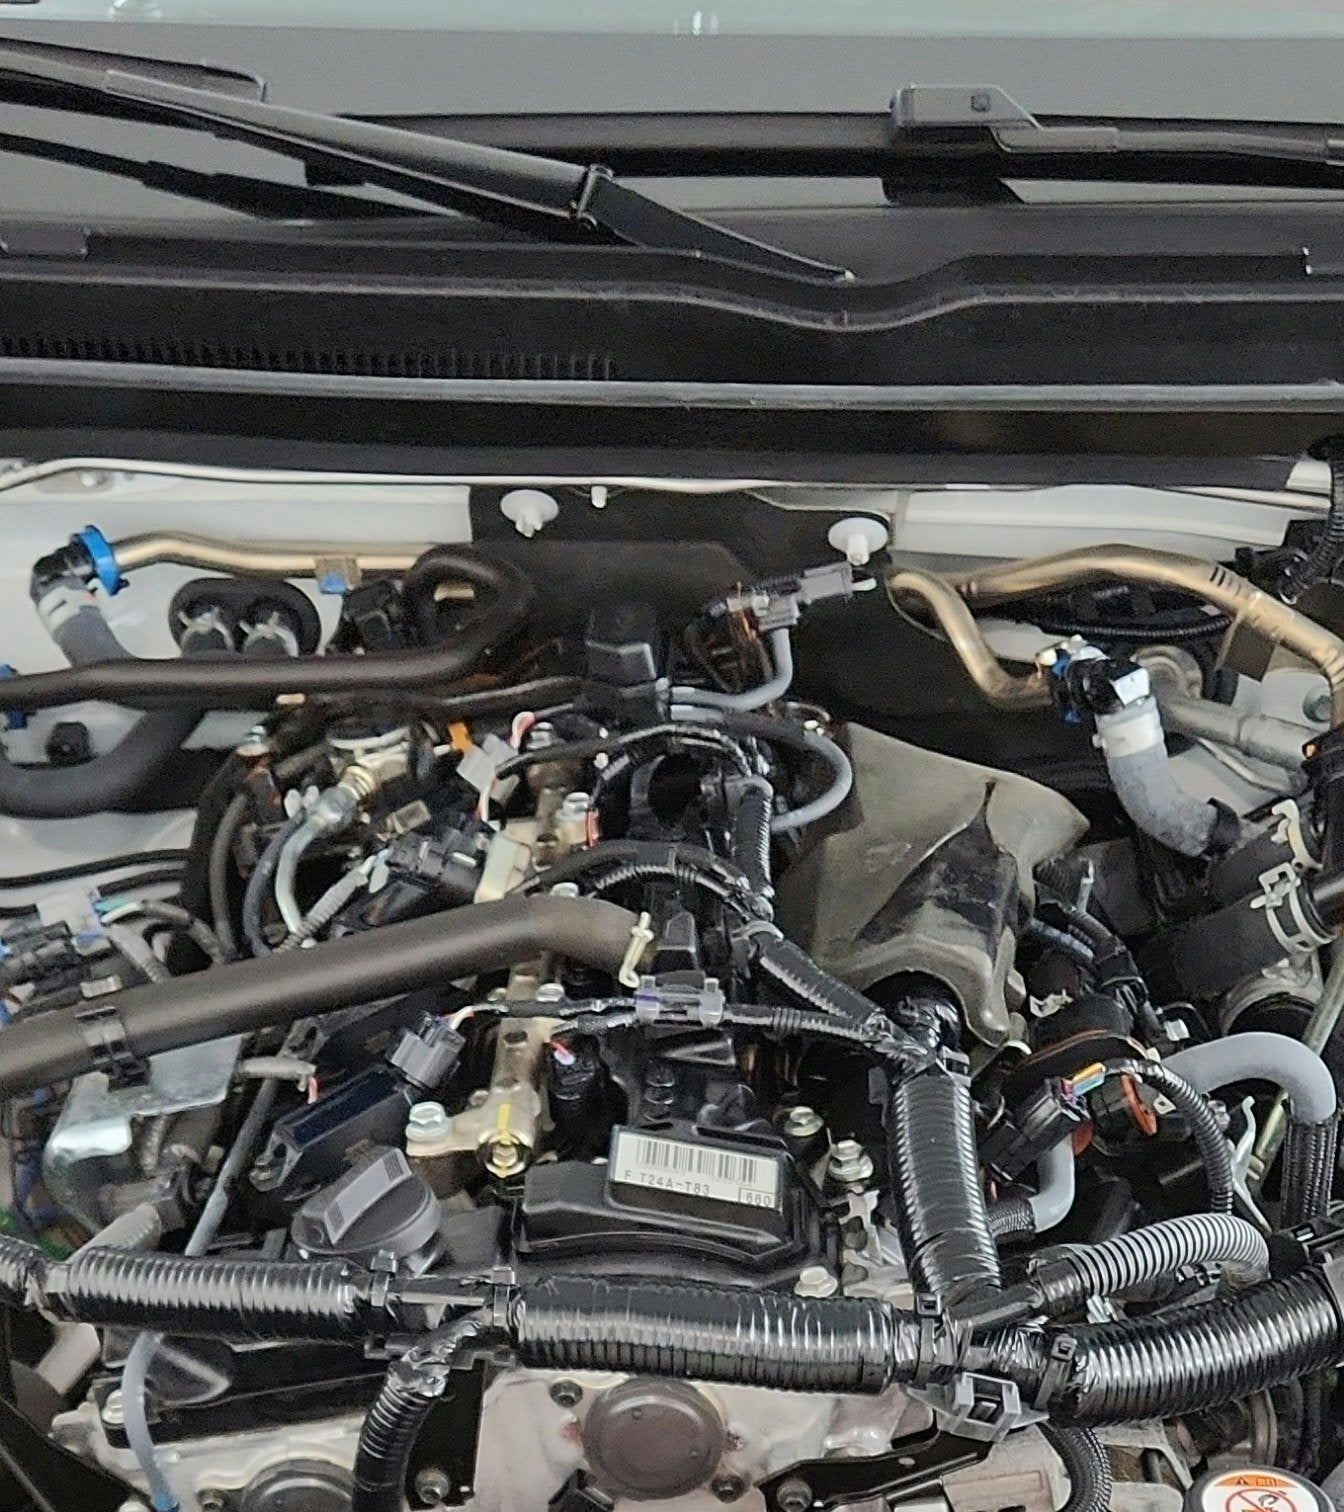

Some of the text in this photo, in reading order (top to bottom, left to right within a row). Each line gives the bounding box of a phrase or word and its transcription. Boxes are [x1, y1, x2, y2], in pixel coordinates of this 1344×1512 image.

[623, 1170, 632, 1181] F
[639, 1172, 710, 1196] T24A-T83
[745, 1192, 772, 1208] 660
